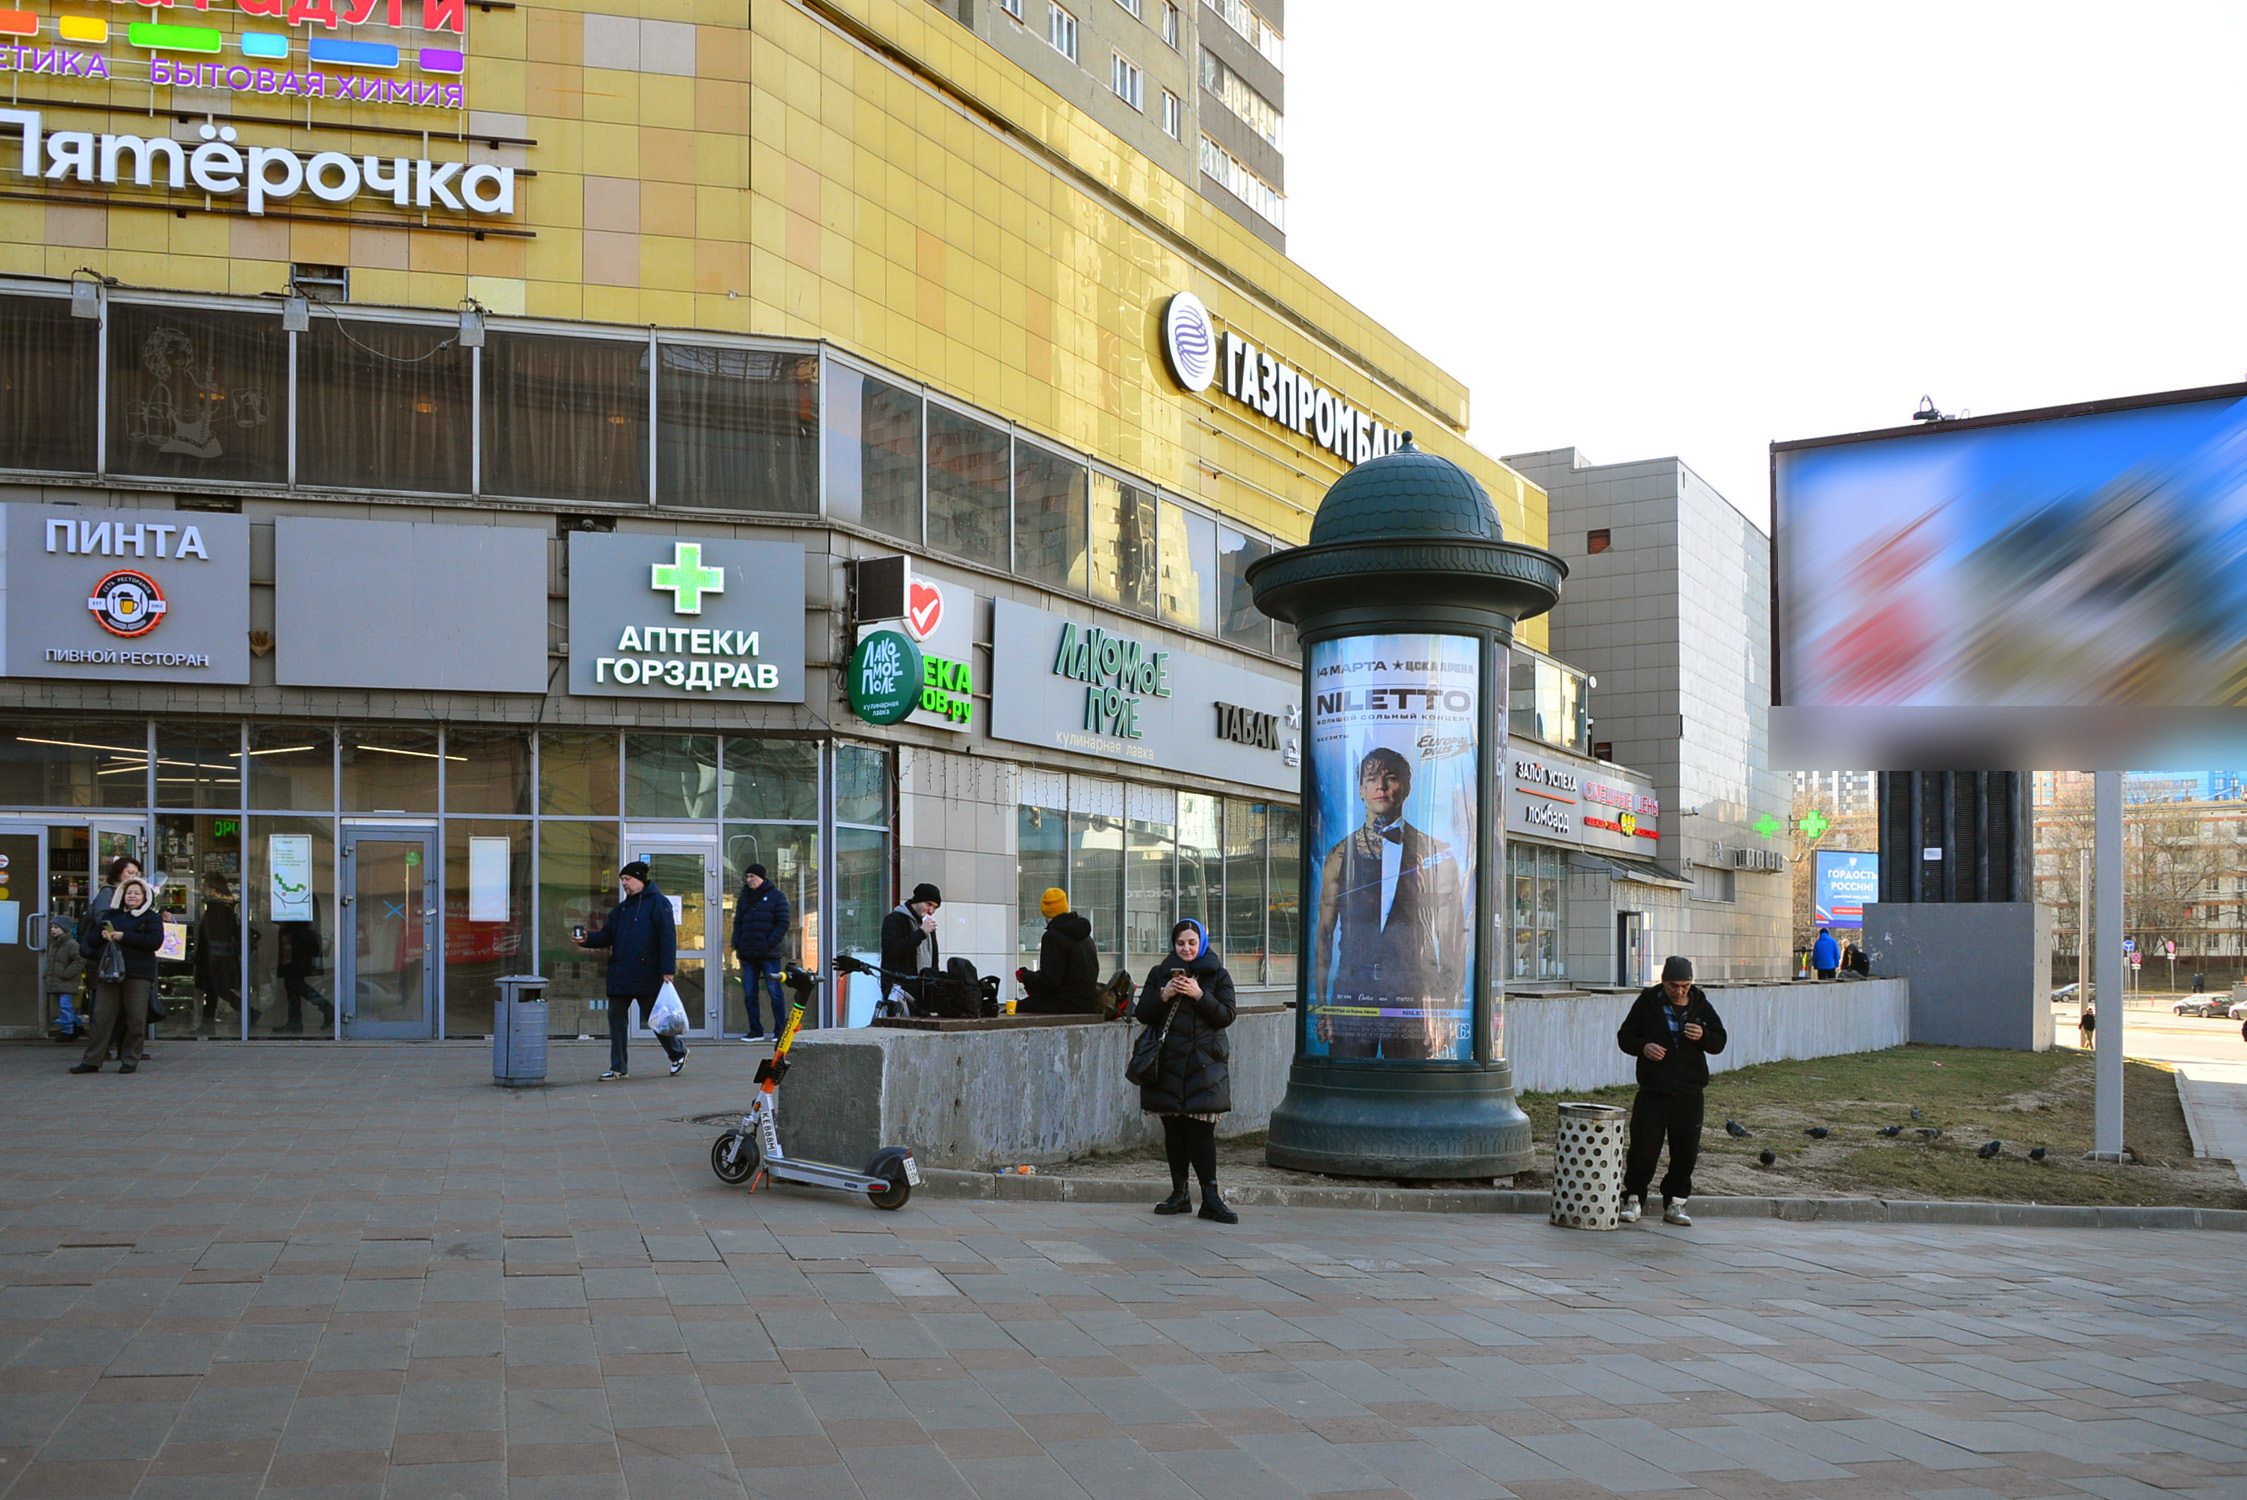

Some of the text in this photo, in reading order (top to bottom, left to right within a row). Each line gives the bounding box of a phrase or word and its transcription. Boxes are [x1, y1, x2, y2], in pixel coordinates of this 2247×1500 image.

[151, 59, 324, 98] БЫТОВАЯ
[335, 74, 464, 109] ХИМИЯ
[46, 519, 209, 560] ПИНТА
[618, 625, 759, 657] АПТЕКИ
[46, 648, 209, 667] ПИВНОЙ РЕСТОРАН
[1330, 661, 1387, 675] МАРТА
[596, 657, 779, 691] ГОРЗДРАВ
[1317, 688, 1471, 716] NILETTO
[1214, 701, 1281, 751] ТАБАК
[1317, 715, 1357, 726] БОЛЬШОЙ
[1360, 713, 1417, 721] СОЛЬНЫЙ
[1056, 731, 1154, 760] кулинарная лавка
[1516, 761, 1577, 792] ЗАЛОГ УСПЕХА
[1525, 803, 1570, 833] ломбард
[1827, 869, 1878, 880] ГОРДОСТЬ
[1831, 882, 1874, 892] РОССИИ!
